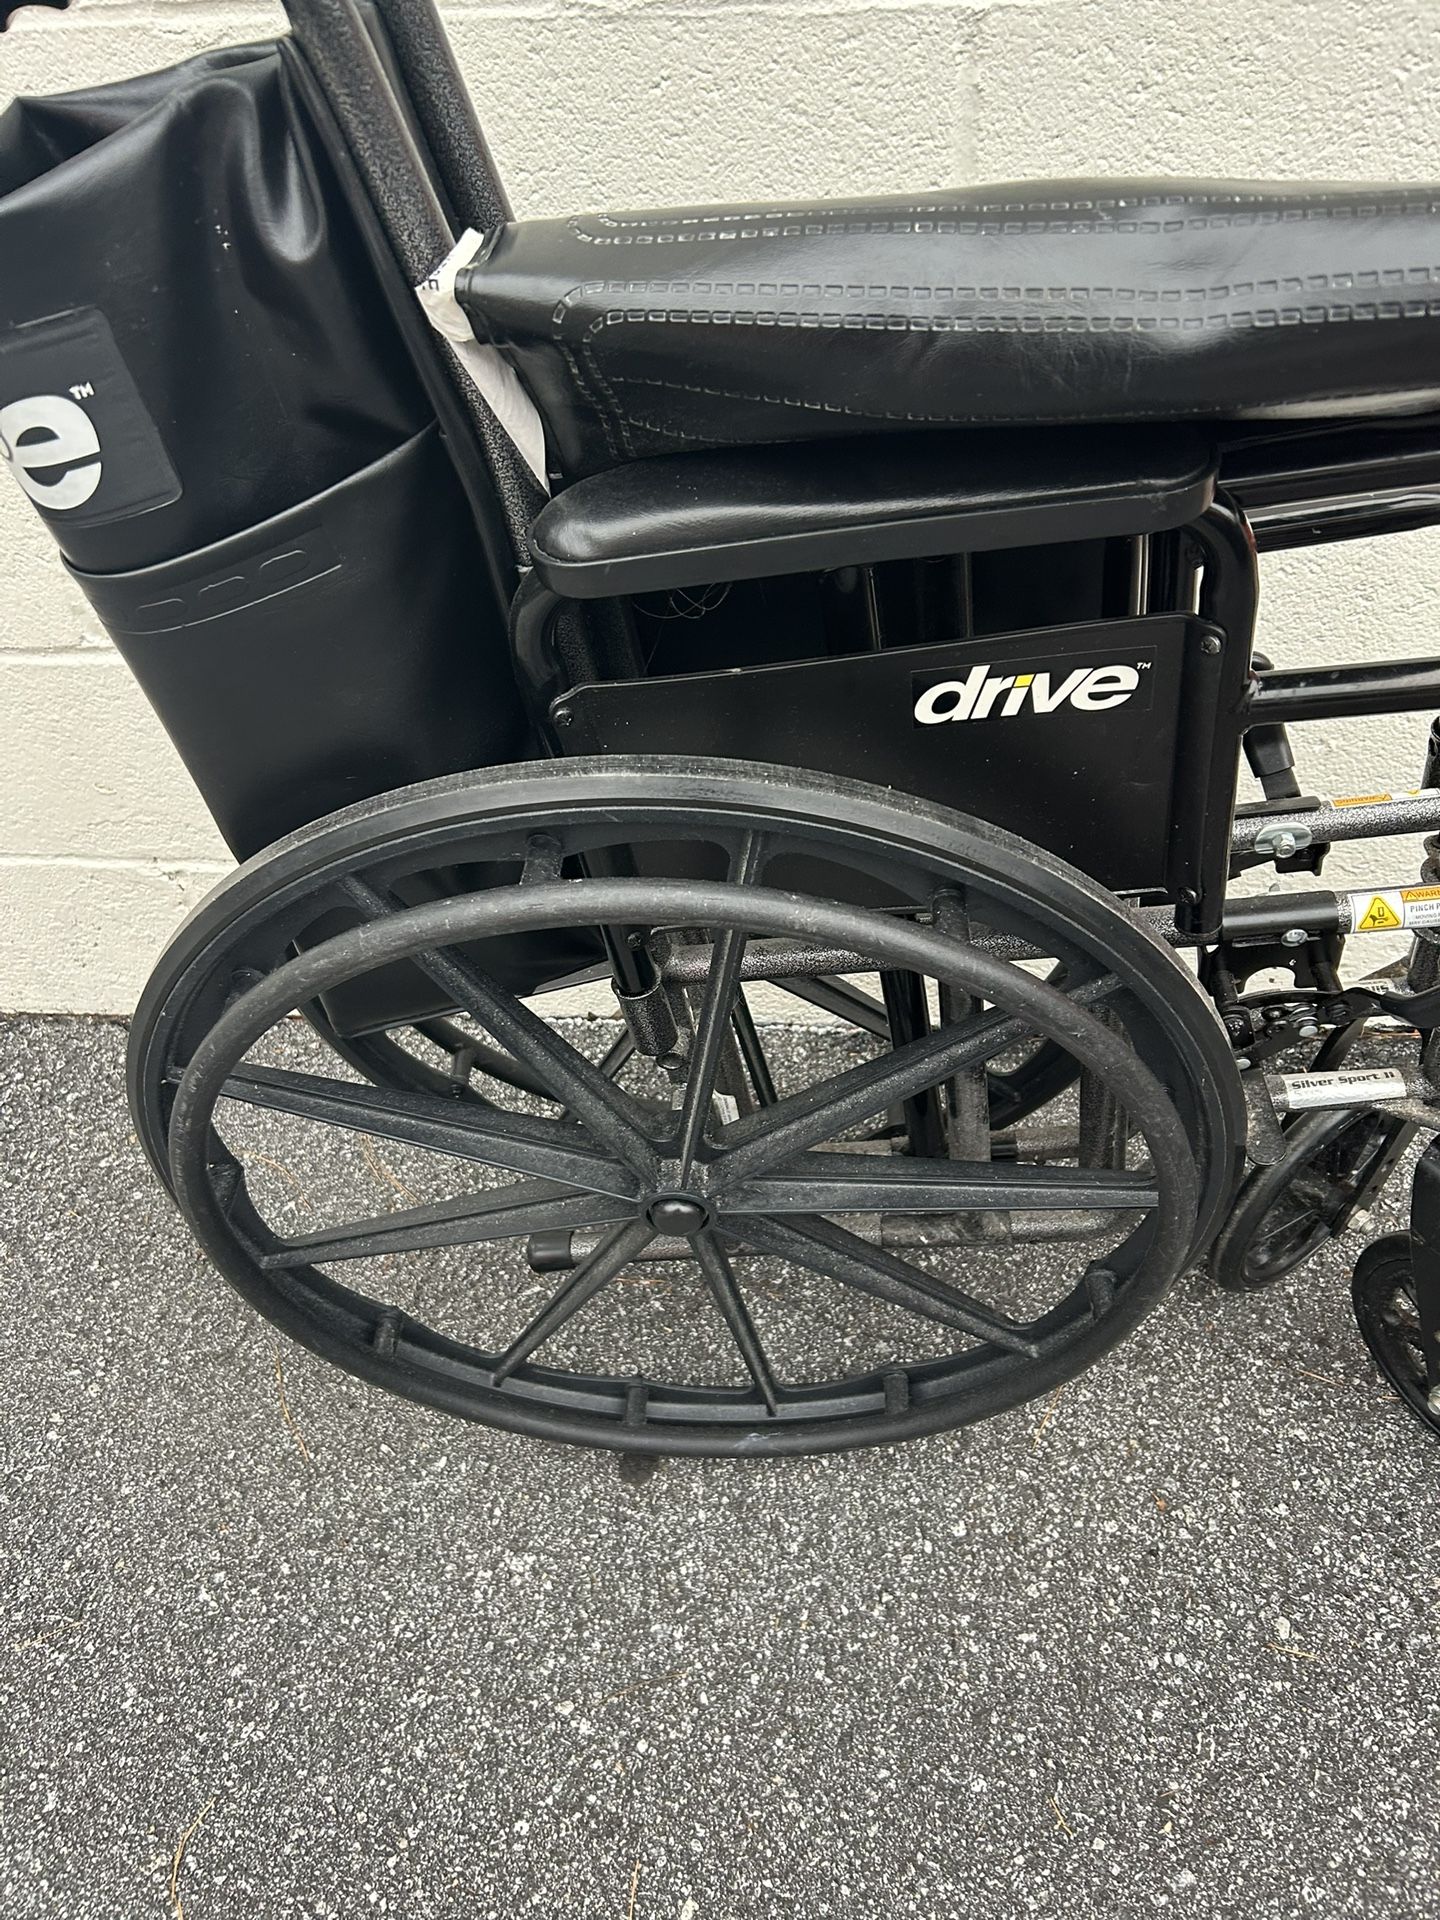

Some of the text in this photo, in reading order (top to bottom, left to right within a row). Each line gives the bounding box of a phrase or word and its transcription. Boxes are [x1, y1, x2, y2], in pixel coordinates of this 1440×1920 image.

[914, 664, 1140, 725] drive
[1410, 903, 1434, 913] PINCH
[1291, 1078, 1334, 1090] Silver
[1338, 1073, 1381, 1085] Sport
